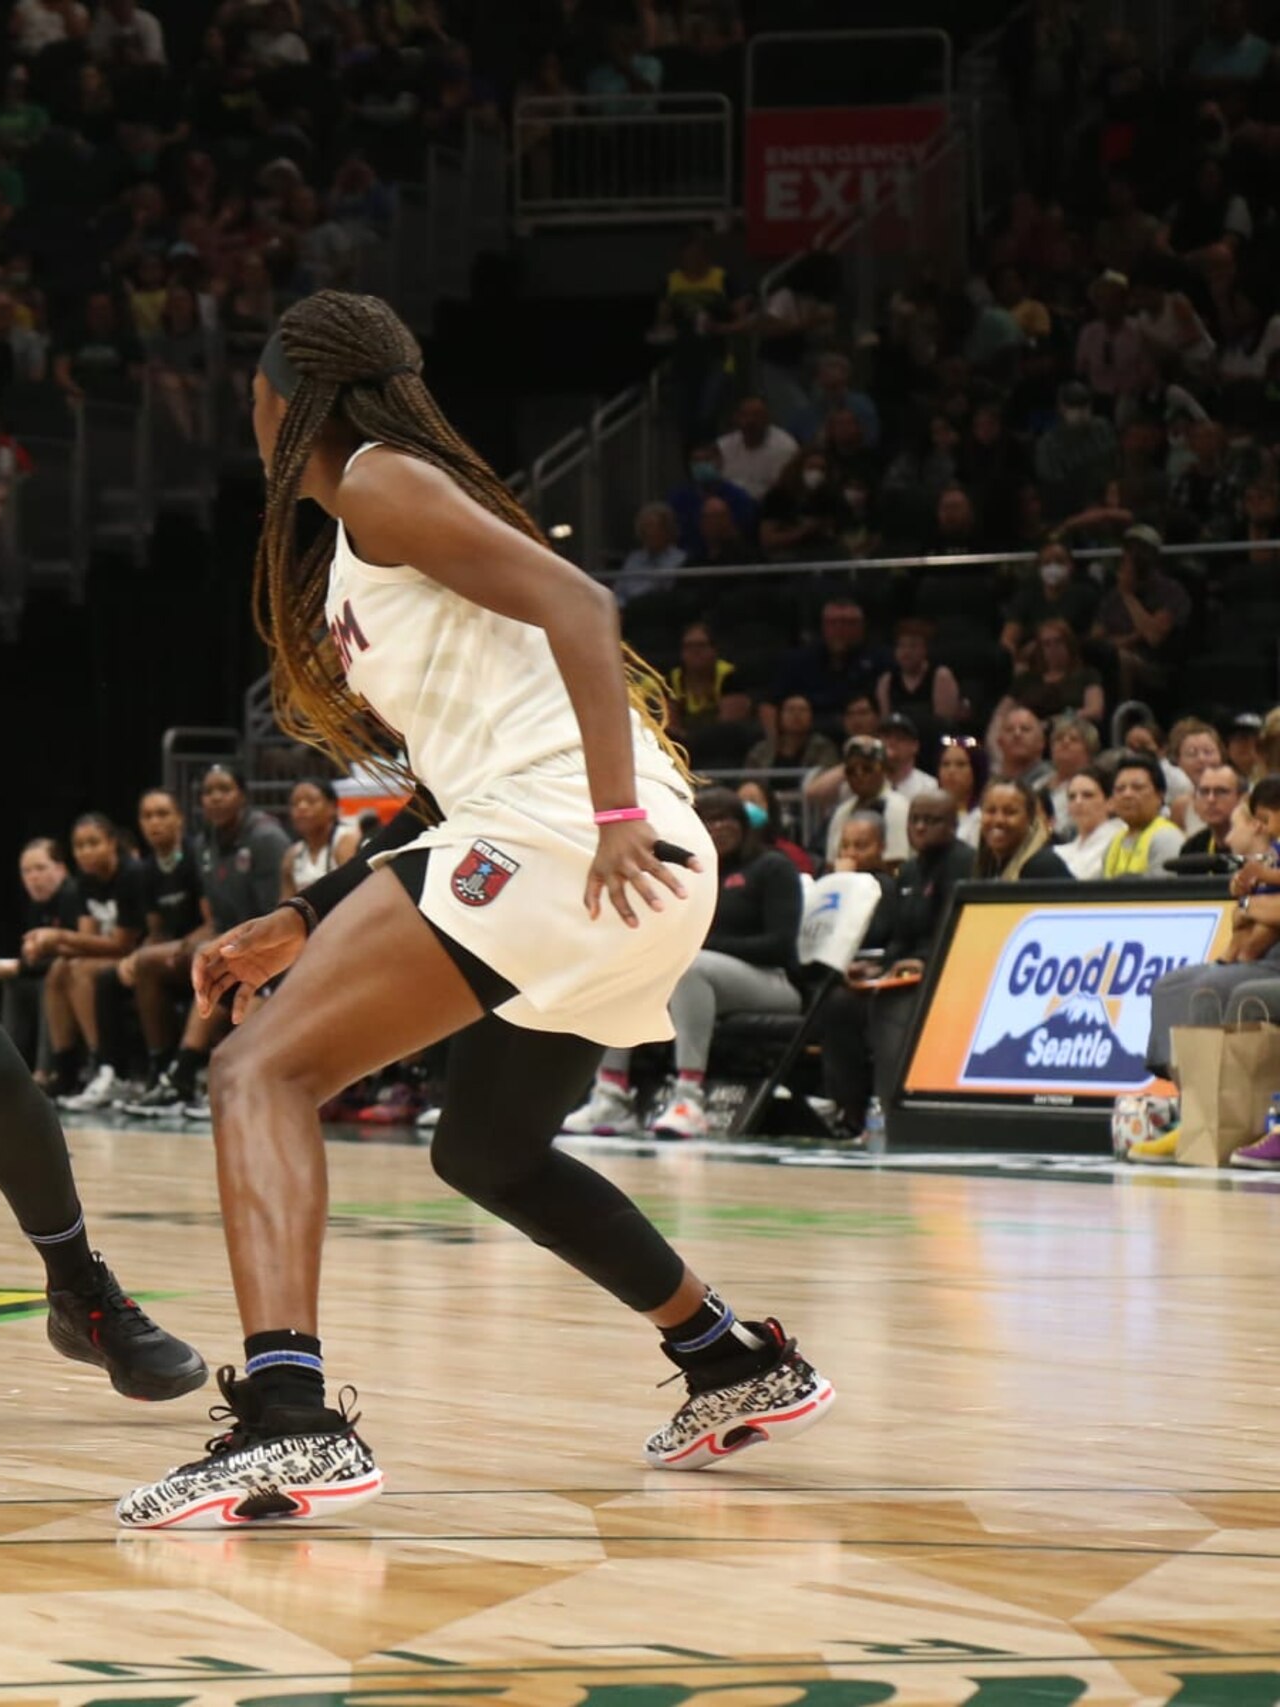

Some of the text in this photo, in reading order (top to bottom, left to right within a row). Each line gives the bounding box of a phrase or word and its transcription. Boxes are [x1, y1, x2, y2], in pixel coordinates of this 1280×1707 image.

[764, 142, 928, 166] EMERGENCY
[764, 166, 918, 222] EXIT
[1008, 940, 1114, 997] Good
[1025, 1026, 1112, 1068] Seattle
